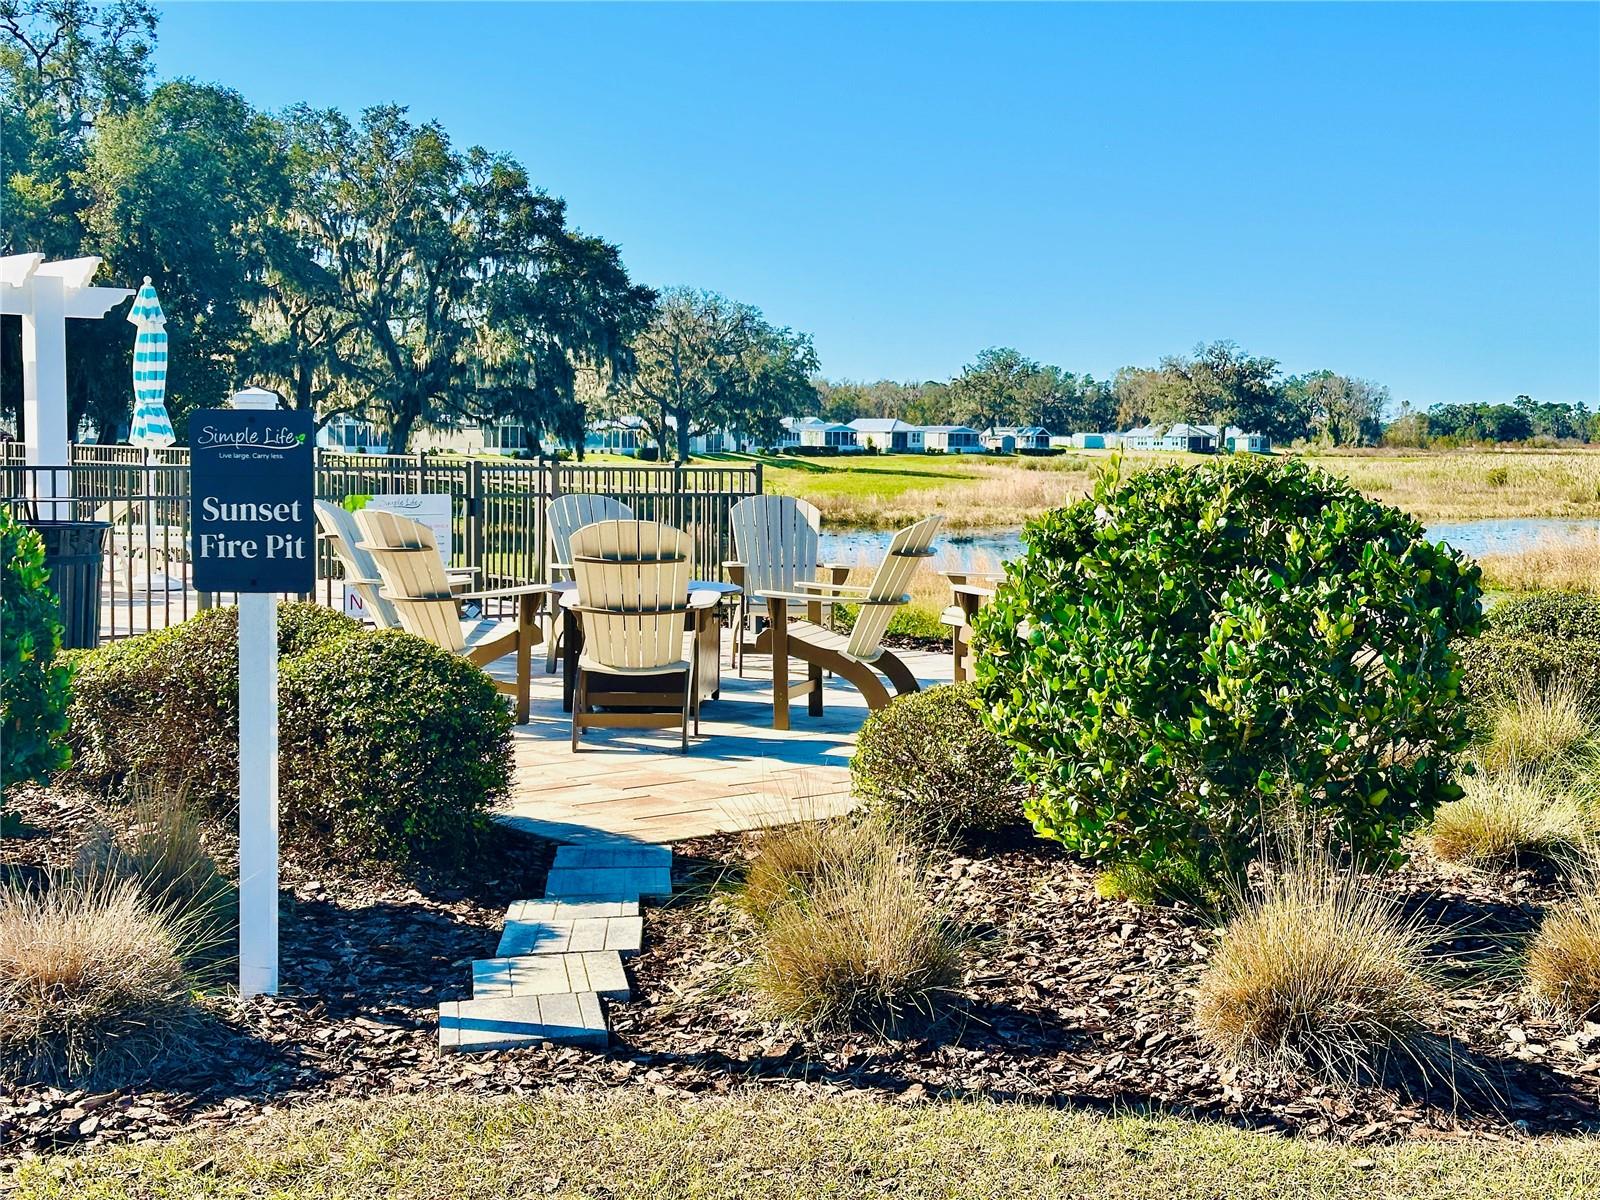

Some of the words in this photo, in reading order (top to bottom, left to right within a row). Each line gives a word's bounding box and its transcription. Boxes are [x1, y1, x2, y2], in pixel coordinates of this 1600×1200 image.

[197, 425, 258, 449] Simple
[263, 427, 295, 444] Life
[233, 452, 250, 461] large.
[252, 452, 269, 461] Carry
[202, 496, 302, 522] Sunset
[200, 533, 258, 559] Fire
[266, 534, 306, 559] Pit
